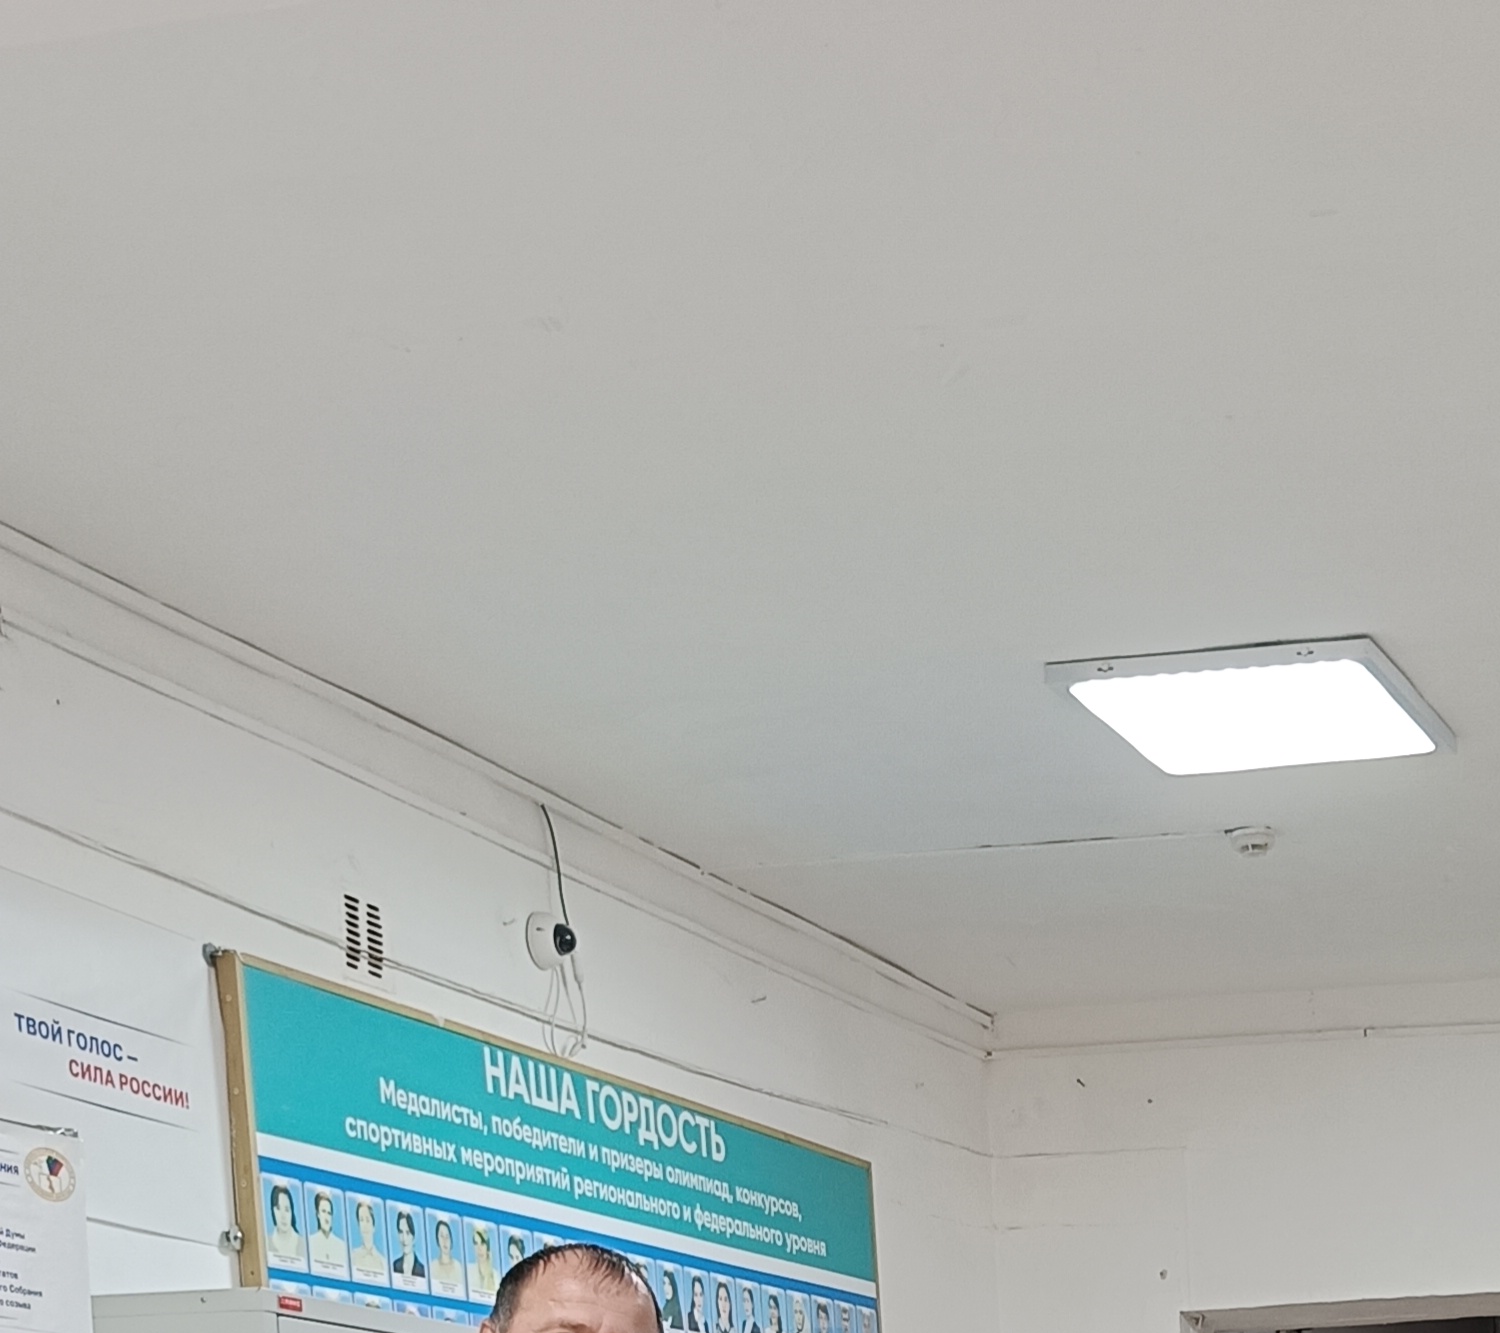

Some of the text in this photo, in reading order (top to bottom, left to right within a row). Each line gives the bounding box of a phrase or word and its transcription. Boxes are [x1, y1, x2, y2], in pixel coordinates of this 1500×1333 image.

[14, 1012, 63, 1045] ТВОЙ
[67, 1028, 123, 1063] ГОЛОС
[68, 1058, 190, 1109] СИЛА РОССИИ!
[379, 1077, 803, 1223] Медалисты, победители и призеры олимпиад, конкурсов,
[484, 1047, 726, 1163] НАША ГОРДОСТЬ
[345, 1116, 827, 1258] спортивных мероприятий регионального и федерального уровня
